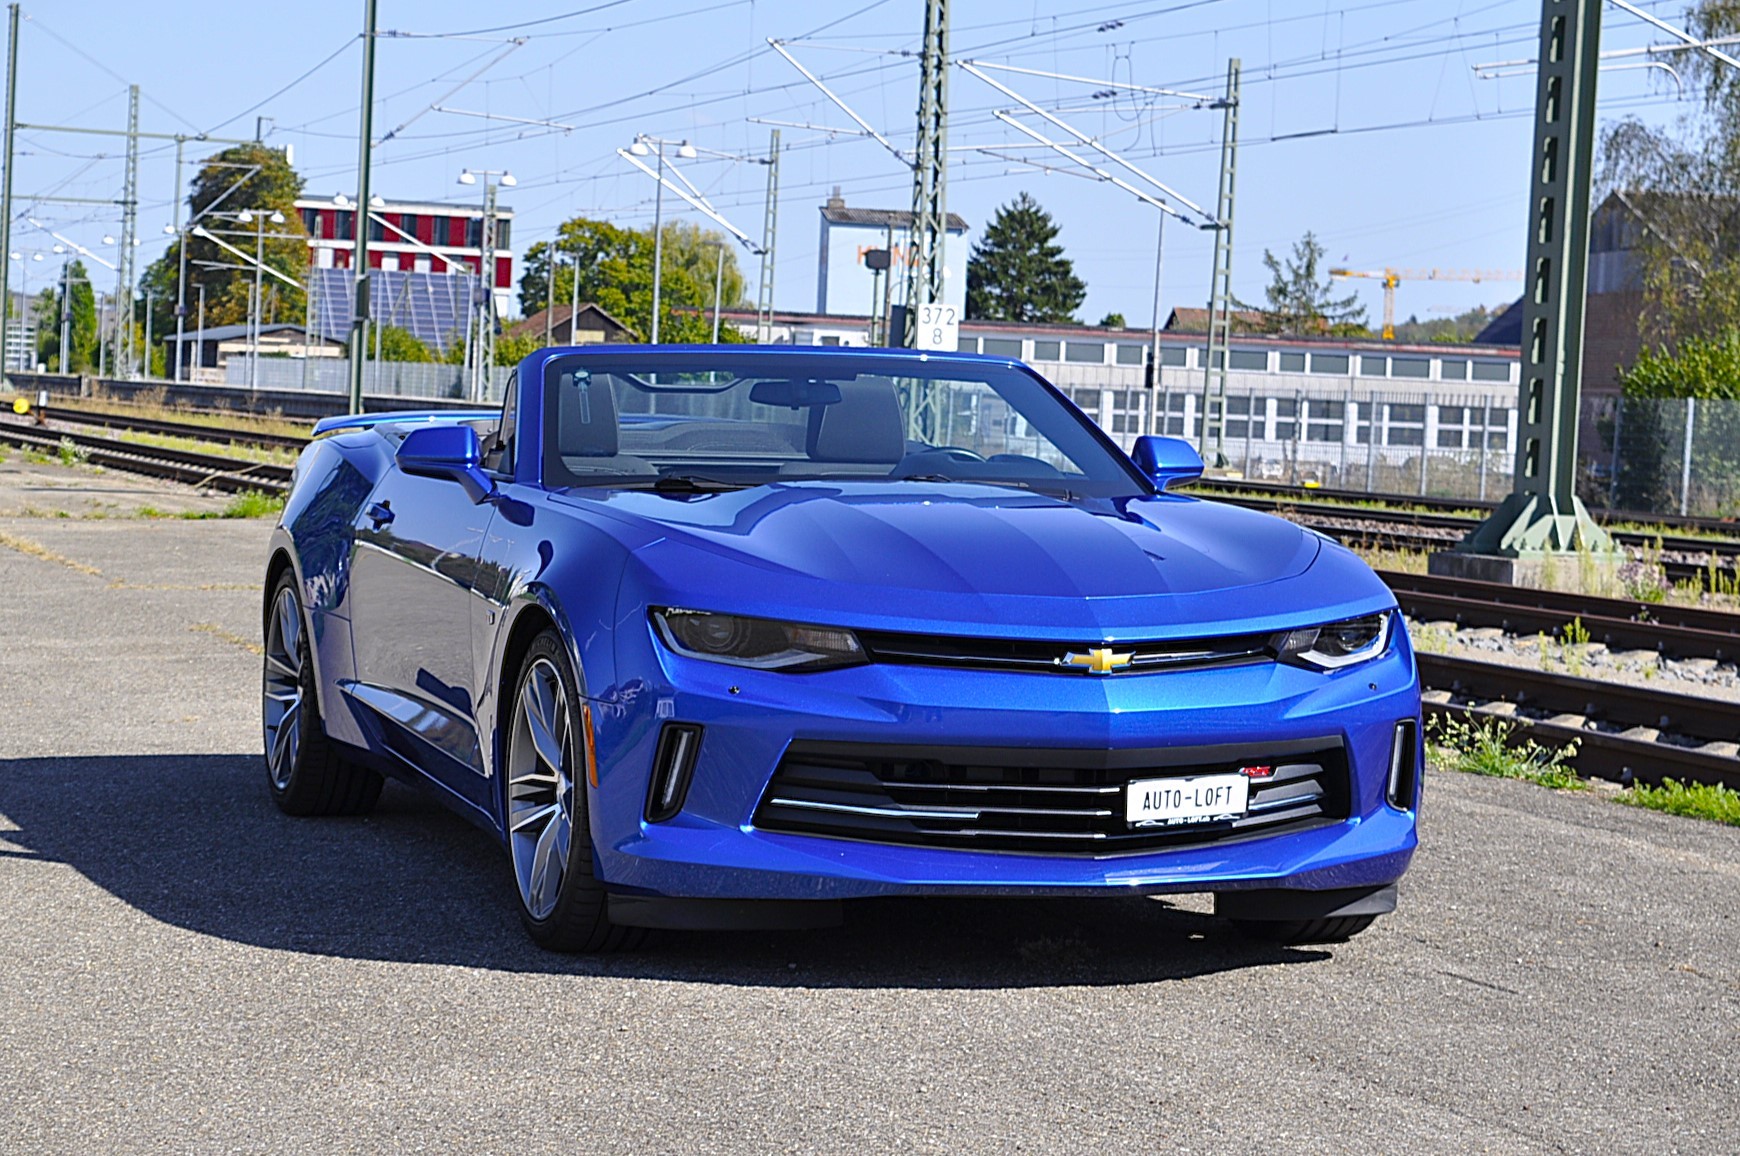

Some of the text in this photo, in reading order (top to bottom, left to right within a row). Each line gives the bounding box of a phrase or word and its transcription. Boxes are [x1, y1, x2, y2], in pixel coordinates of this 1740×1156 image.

[922, 307, 955, 326] 372
[932, 328, 942, 345] 8
[1143, 786, 1233, 811] AUTO-LOFT
